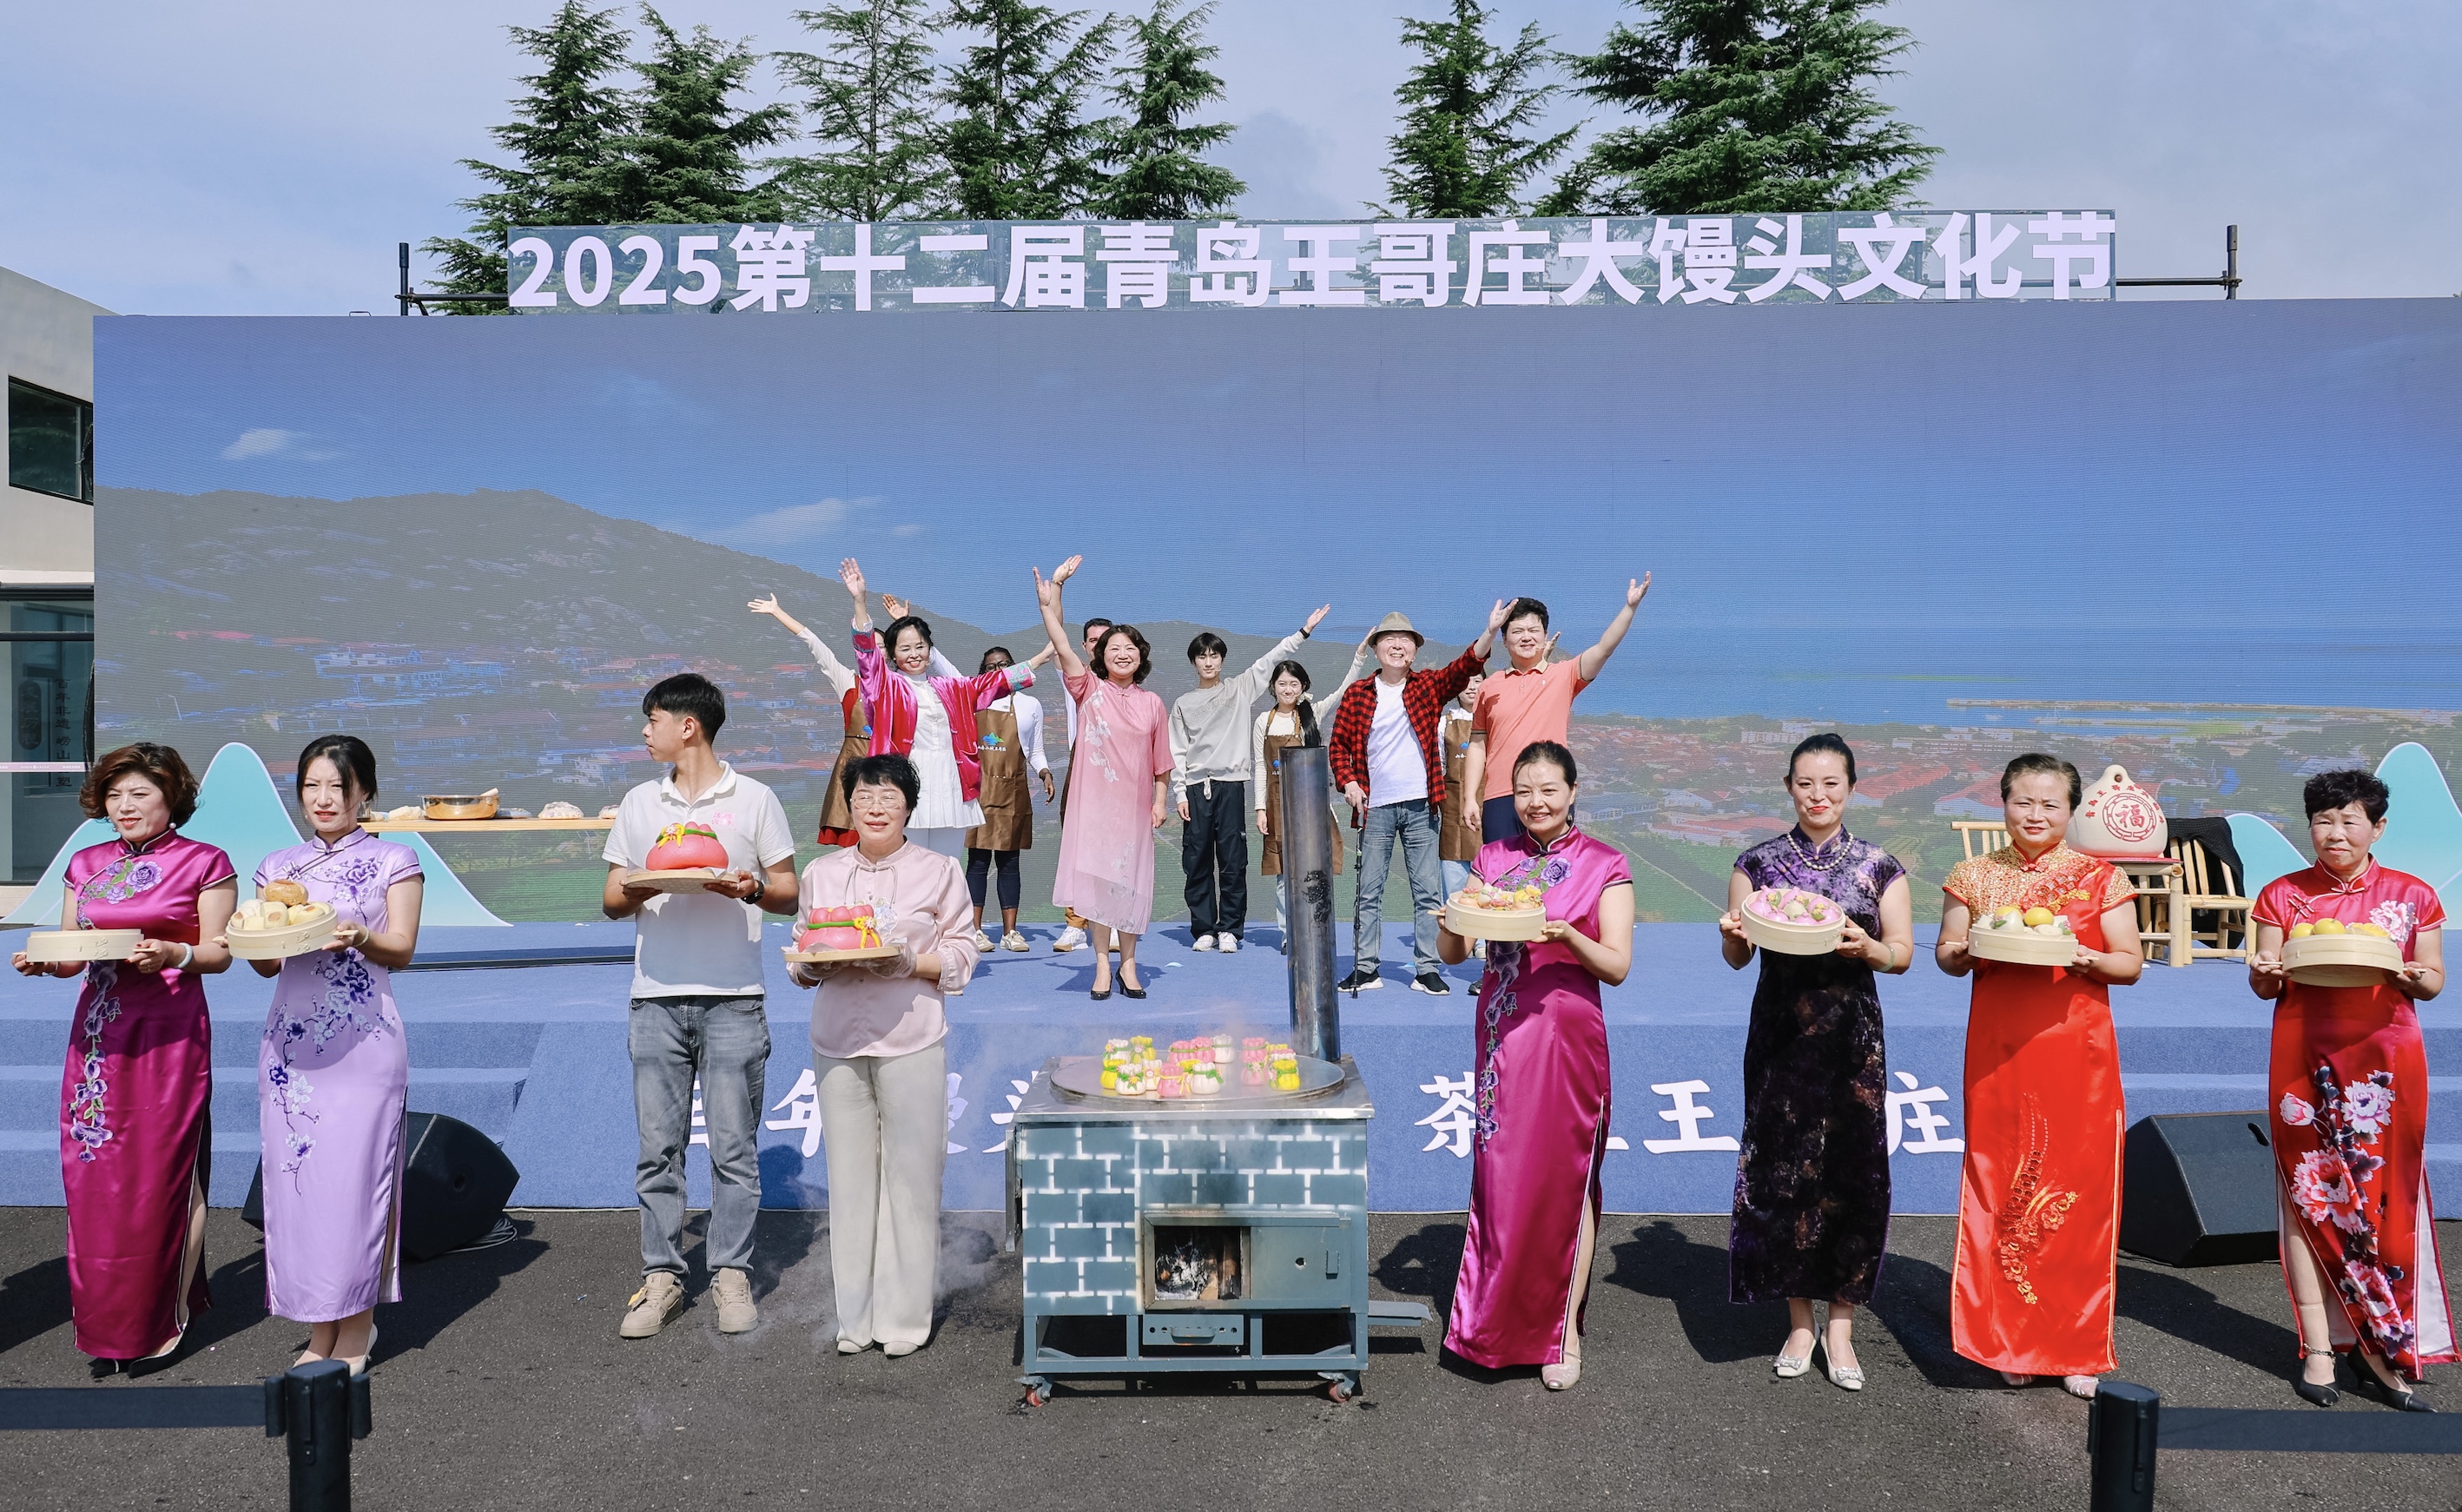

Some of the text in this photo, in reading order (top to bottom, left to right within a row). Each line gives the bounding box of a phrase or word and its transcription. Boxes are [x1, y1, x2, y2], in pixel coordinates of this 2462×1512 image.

[508, 211, 2116, 312] 2025第十二届青岛王哥庄大馒头文化节
[2115, 803, 2146, 829] 福
